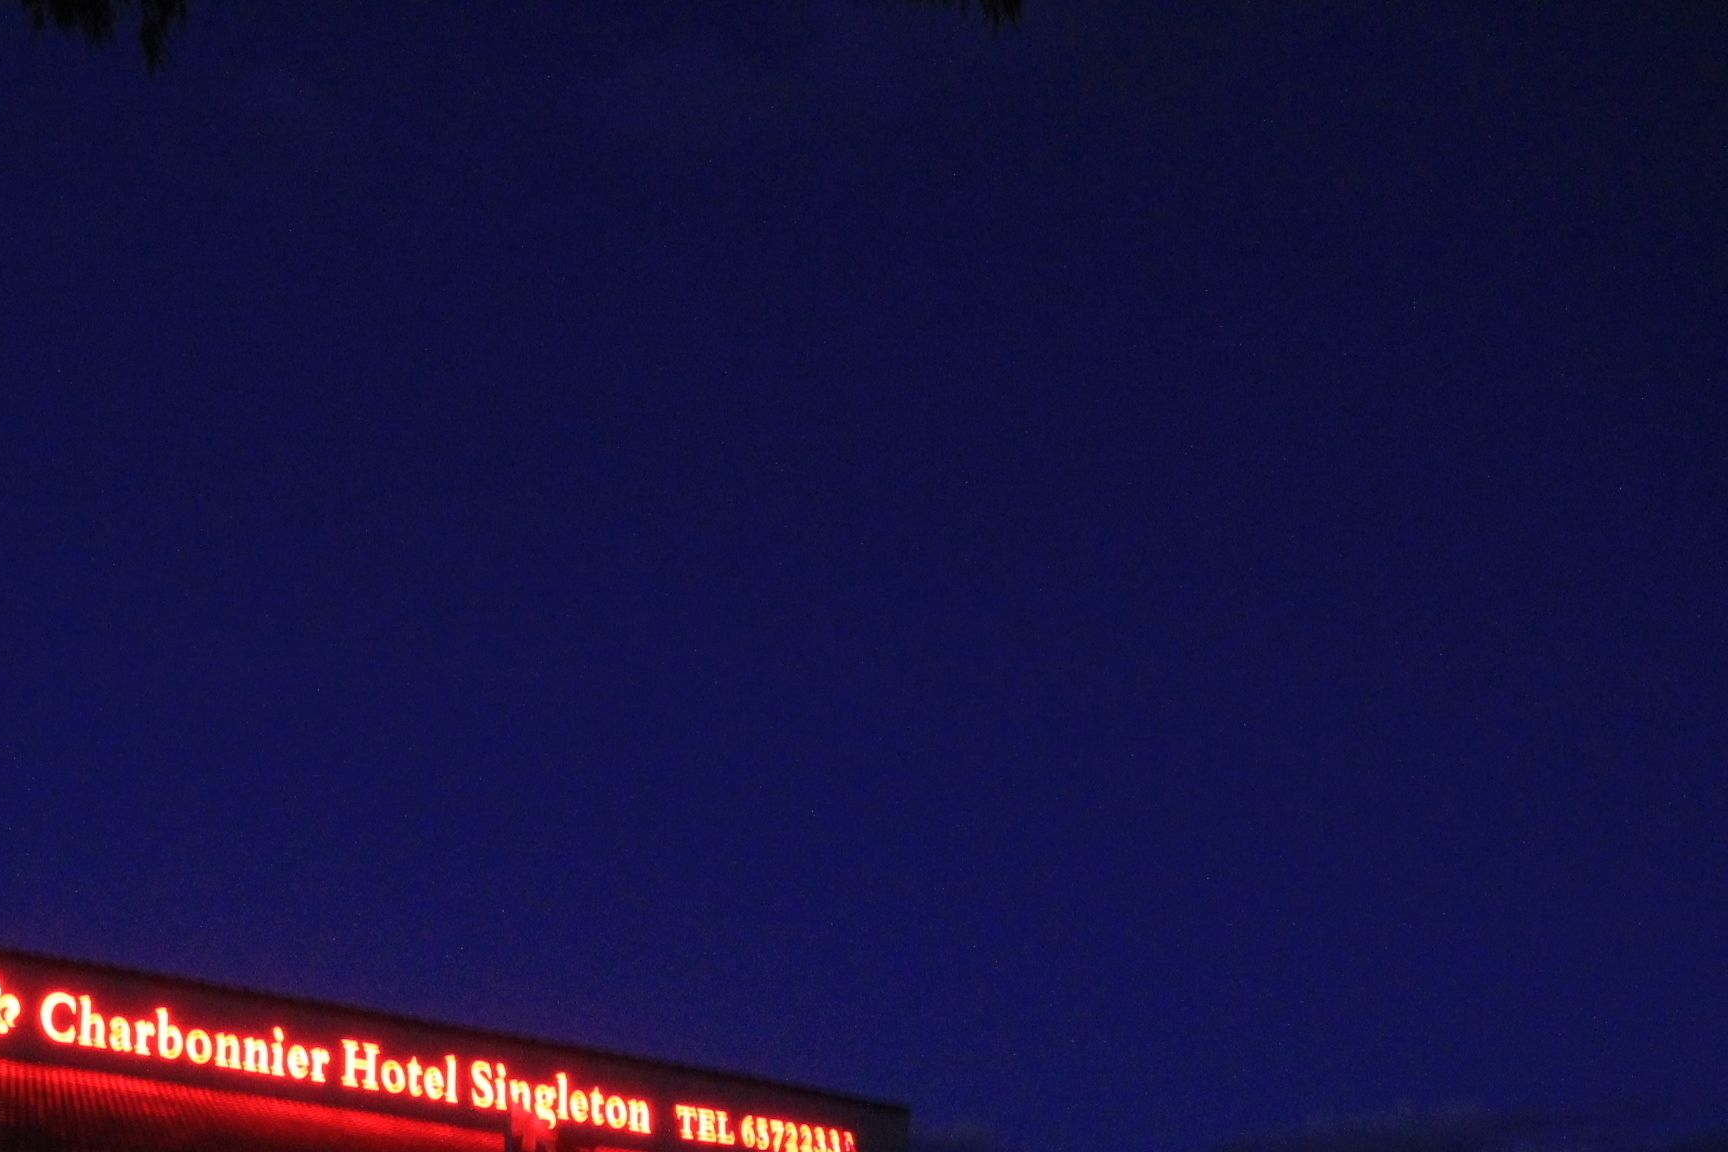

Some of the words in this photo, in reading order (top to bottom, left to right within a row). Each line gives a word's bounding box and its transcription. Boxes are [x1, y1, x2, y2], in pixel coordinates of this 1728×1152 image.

[39, 991, 330, 1083] Charbonnier
[341, 1038, 459, 1103] Hotel
[471, 1060, 651, 1134] Singleton
[675, 1104, 736, 1145] TEL
